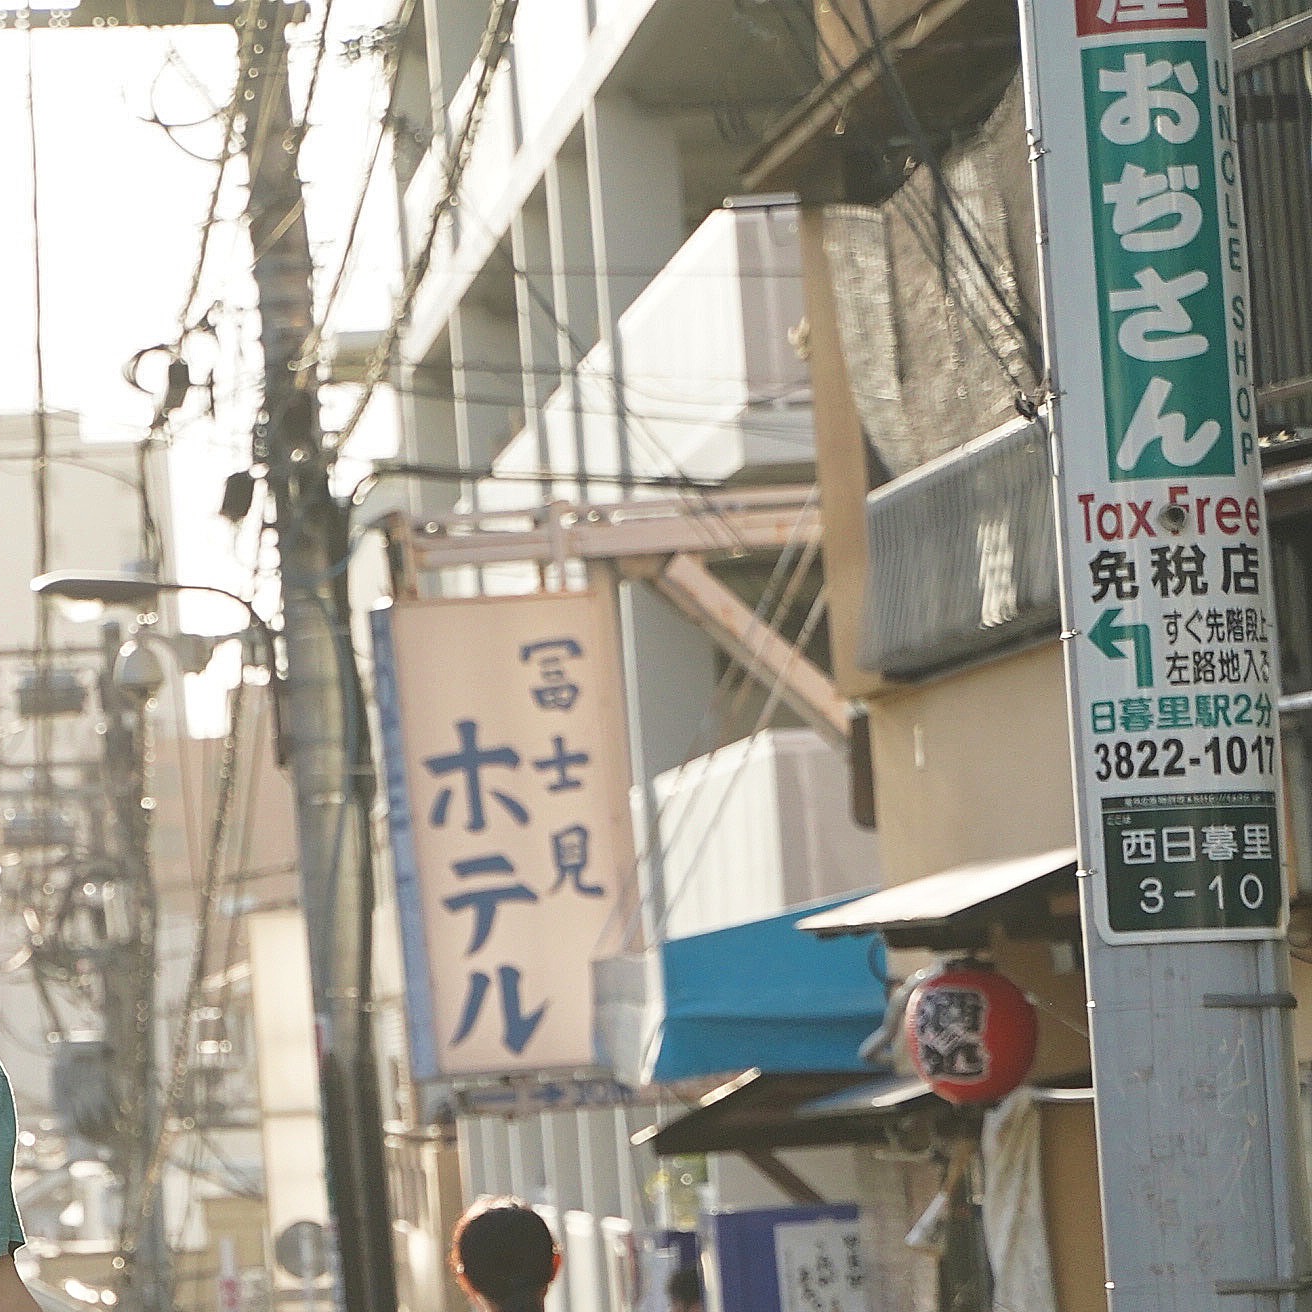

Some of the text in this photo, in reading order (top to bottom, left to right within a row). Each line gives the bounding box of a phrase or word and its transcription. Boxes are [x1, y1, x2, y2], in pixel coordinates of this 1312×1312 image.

[1097, 52, 1221, 472] おぢさん
[1214, 59, 1254, 466] UNCLE SHOP
[1077, 485, 1260, 543] Tax Free
[1088, 542, 1260, 603] 免税店
[1165, 648, 1271, 687] 左路地入る
[1090, 692, 1273, 735] 日暮里駅2分
[1093, 735, 1276, 783] 3822-1017
[1120, 823, 1273, 865] 西日暮里
[421, 720, 550, 1056] ホテル
[1138, 872, 1265, 915] 3-10
